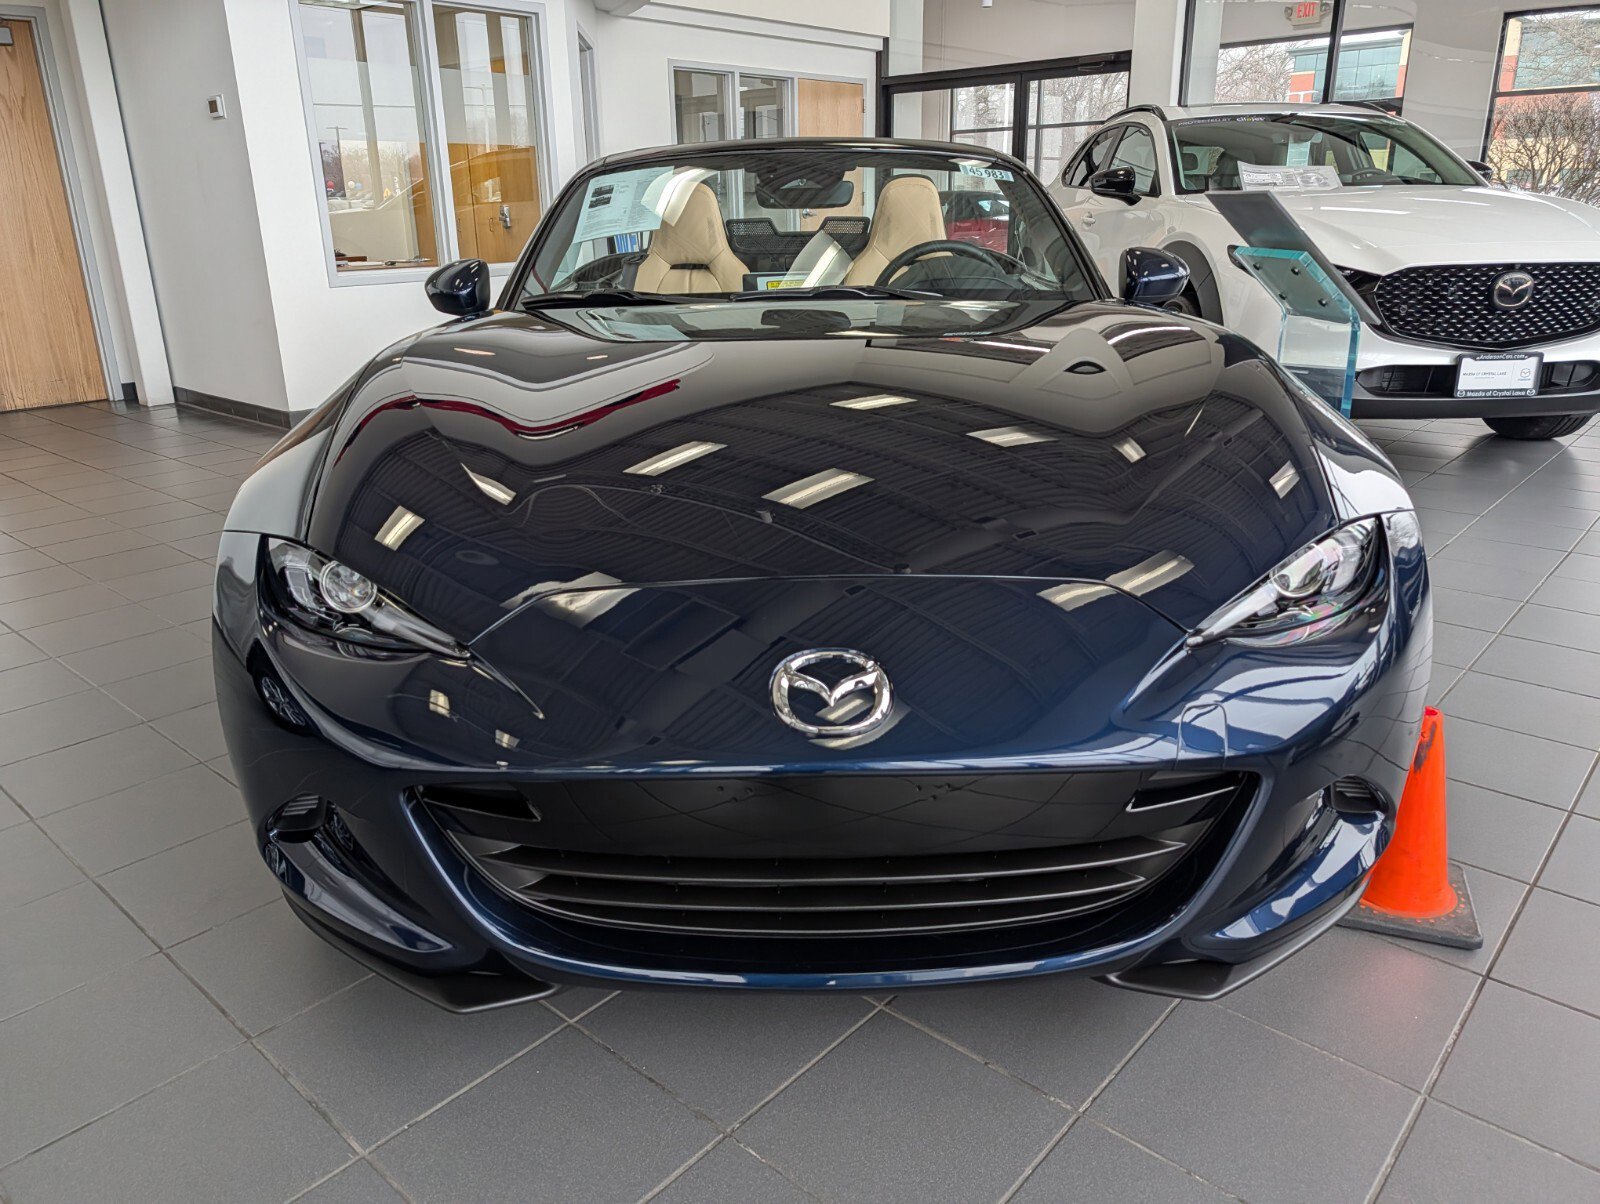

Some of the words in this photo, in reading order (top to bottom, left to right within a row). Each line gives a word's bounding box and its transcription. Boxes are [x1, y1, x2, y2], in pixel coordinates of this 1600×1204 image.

[1296, 2, 1317, 18] EXIT
[969, 166, 983, 177] 45
[984, 169, 1005, 179] 983
